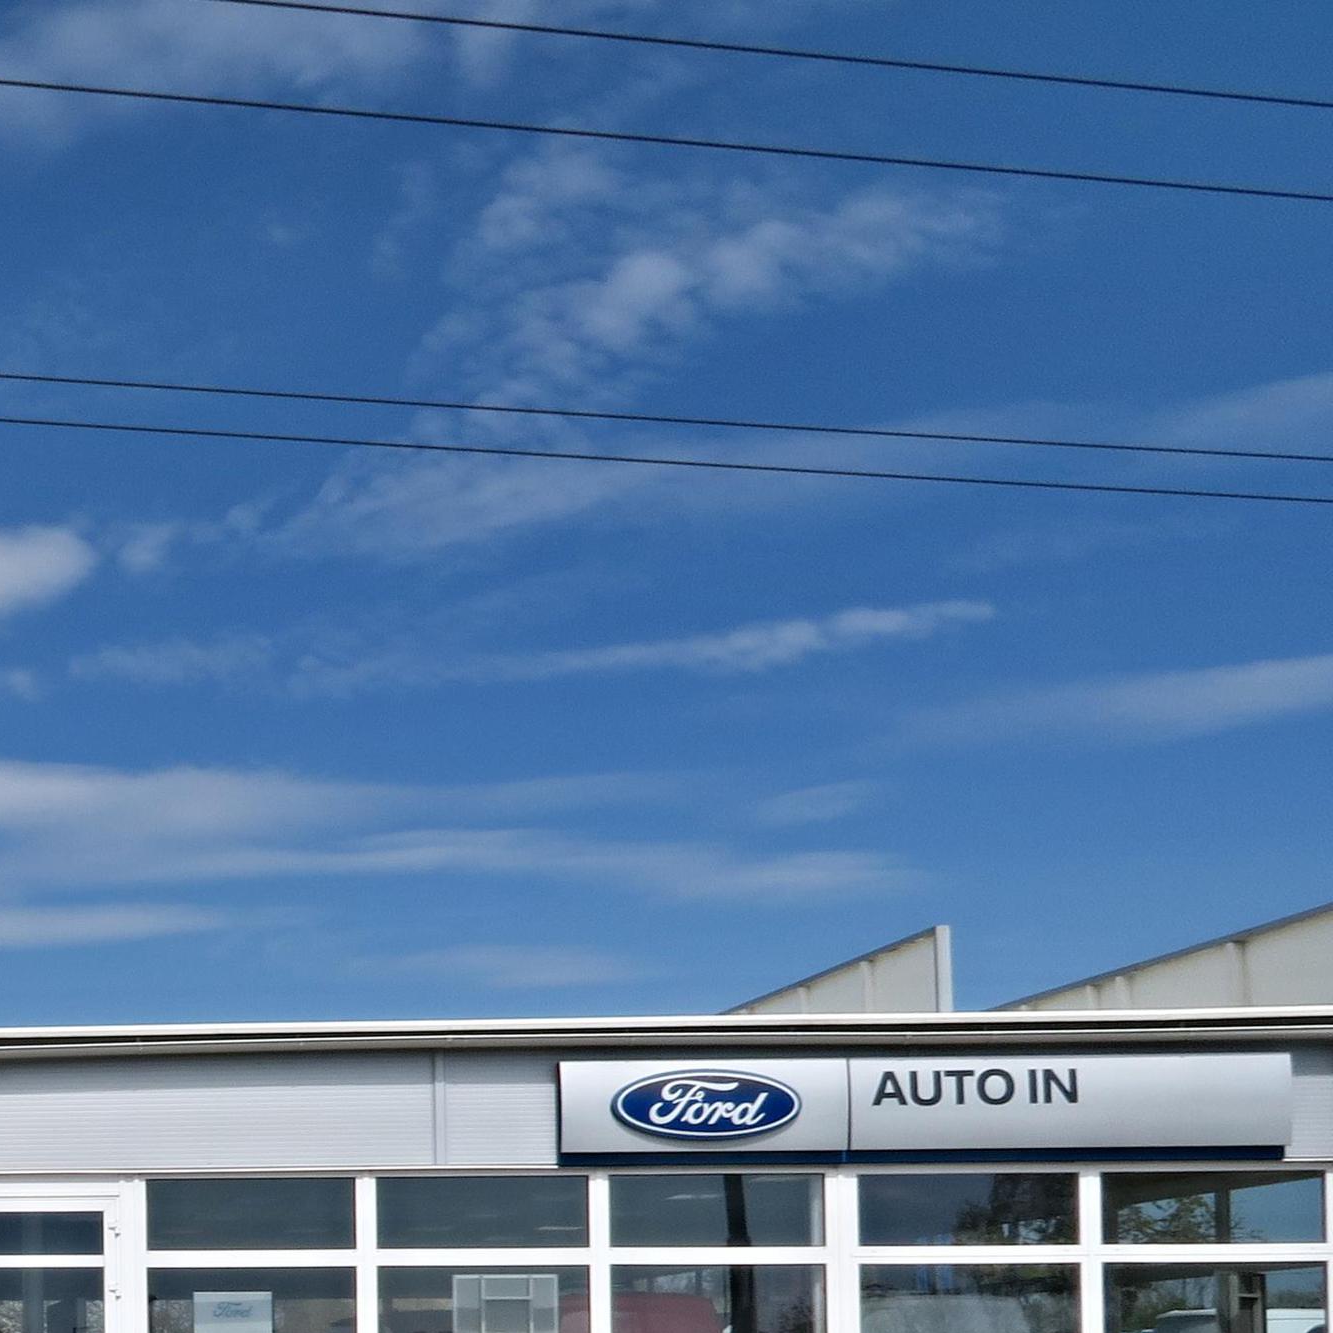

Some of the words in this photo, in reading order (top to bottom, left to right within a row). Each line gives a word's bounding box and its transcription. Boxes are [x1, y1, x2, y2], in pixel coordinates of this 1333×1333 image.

[649, 1079, 769, 1125] Ford
[872, 1068, 1015, 1106] AUTO
[1028, 1068, 1079, 1104] IN
